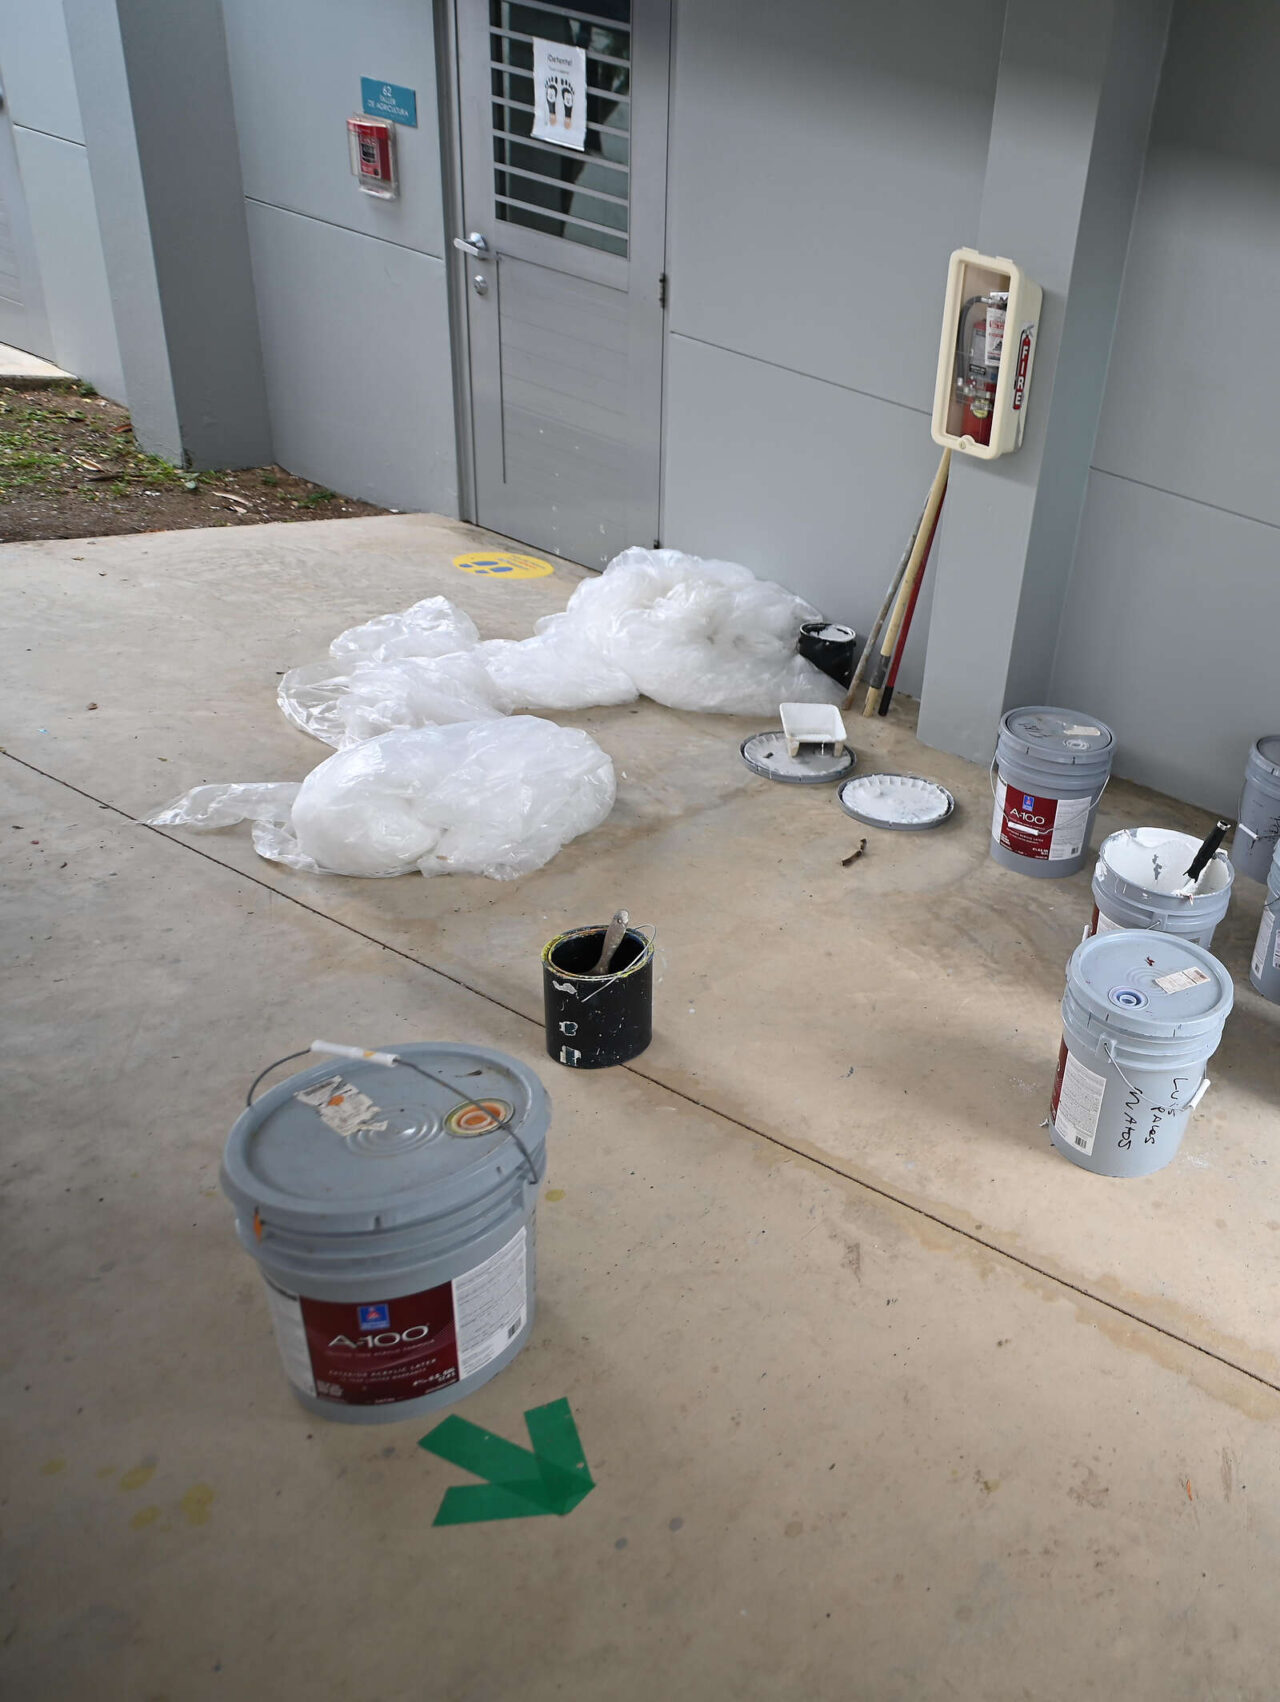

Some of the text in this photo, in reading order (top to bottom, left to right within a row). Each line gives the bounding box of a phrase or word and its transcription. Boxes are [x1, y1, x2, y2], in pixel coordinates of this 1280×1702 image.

[382, 85, 392, 97] 62
[1015, 345, 1029, 405] FIRE
[1009, 808, 1045, 825] A-100
[328, 1325, 430, 1349] A-100
